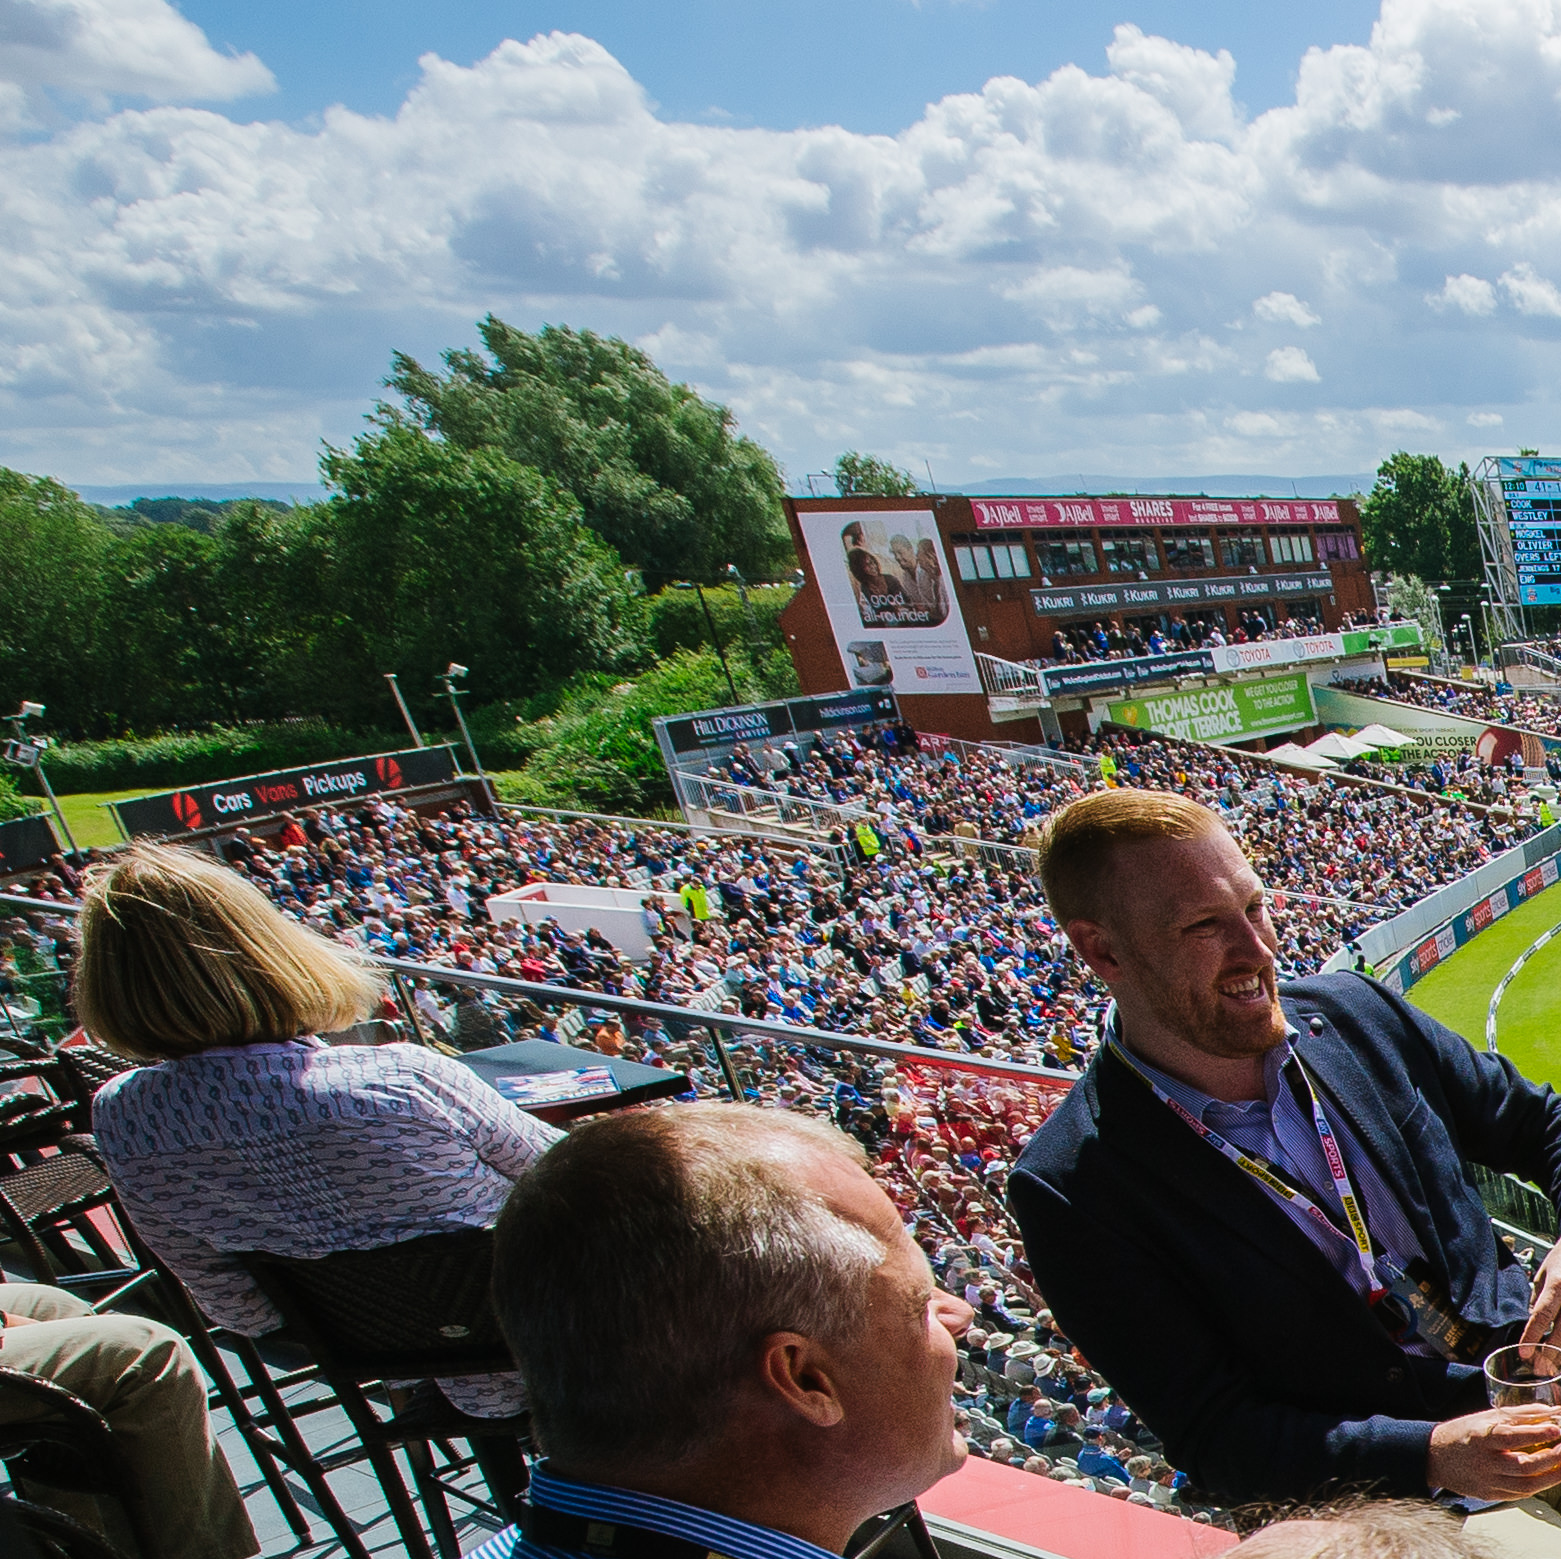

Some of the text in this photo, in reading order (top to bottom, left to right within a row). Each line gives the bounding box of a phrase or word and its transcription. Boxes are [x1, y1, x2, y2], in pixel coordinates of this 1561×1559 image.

[1504, 482, 1524, 491] 12:10
[990, 501, 1339, 526] AJBell AJBell SHARES AJBell AJBell
[1511, 500, 1532, 508] COOK
[1512, 512, 1548, 520] WESTLEY
[1518, 541, 1552, 549] OLIVIER
[1515, 552, 1540, 561] OVERS
[1520, 575, 1535, 583] ENG
[871, 592, 904, 608] good
[1044, 578, 1332, 609] KUKRI KUKRI KUKRI KUKRI KUKRI KUKRI KUKRI KUKRI
[864, 609, 930, 622] all-rounder
[1240, 640, 1335, 664] TOYOTA TOYOTA
[1144, 688, 1238, 724] THOMAS COOK
[693, 713, 768, 736] HILL DICKINSON
[1191, 711, 1243, 738] TERRACE
[1435, 736, 1476, 746] CLOSER
[1401, 750, 1421, 759] THE
[212, 770, 367, 813] Cars Vans Pickups
[1526, 874, 1543, 892] sports
[1474, 908, 1492, 928] sports
[1420, 946, 1438, 970] sports
[1321, 1136, 1346, 1179] SPORTS
[1353, 1221, 1370, 1252] SPORT
